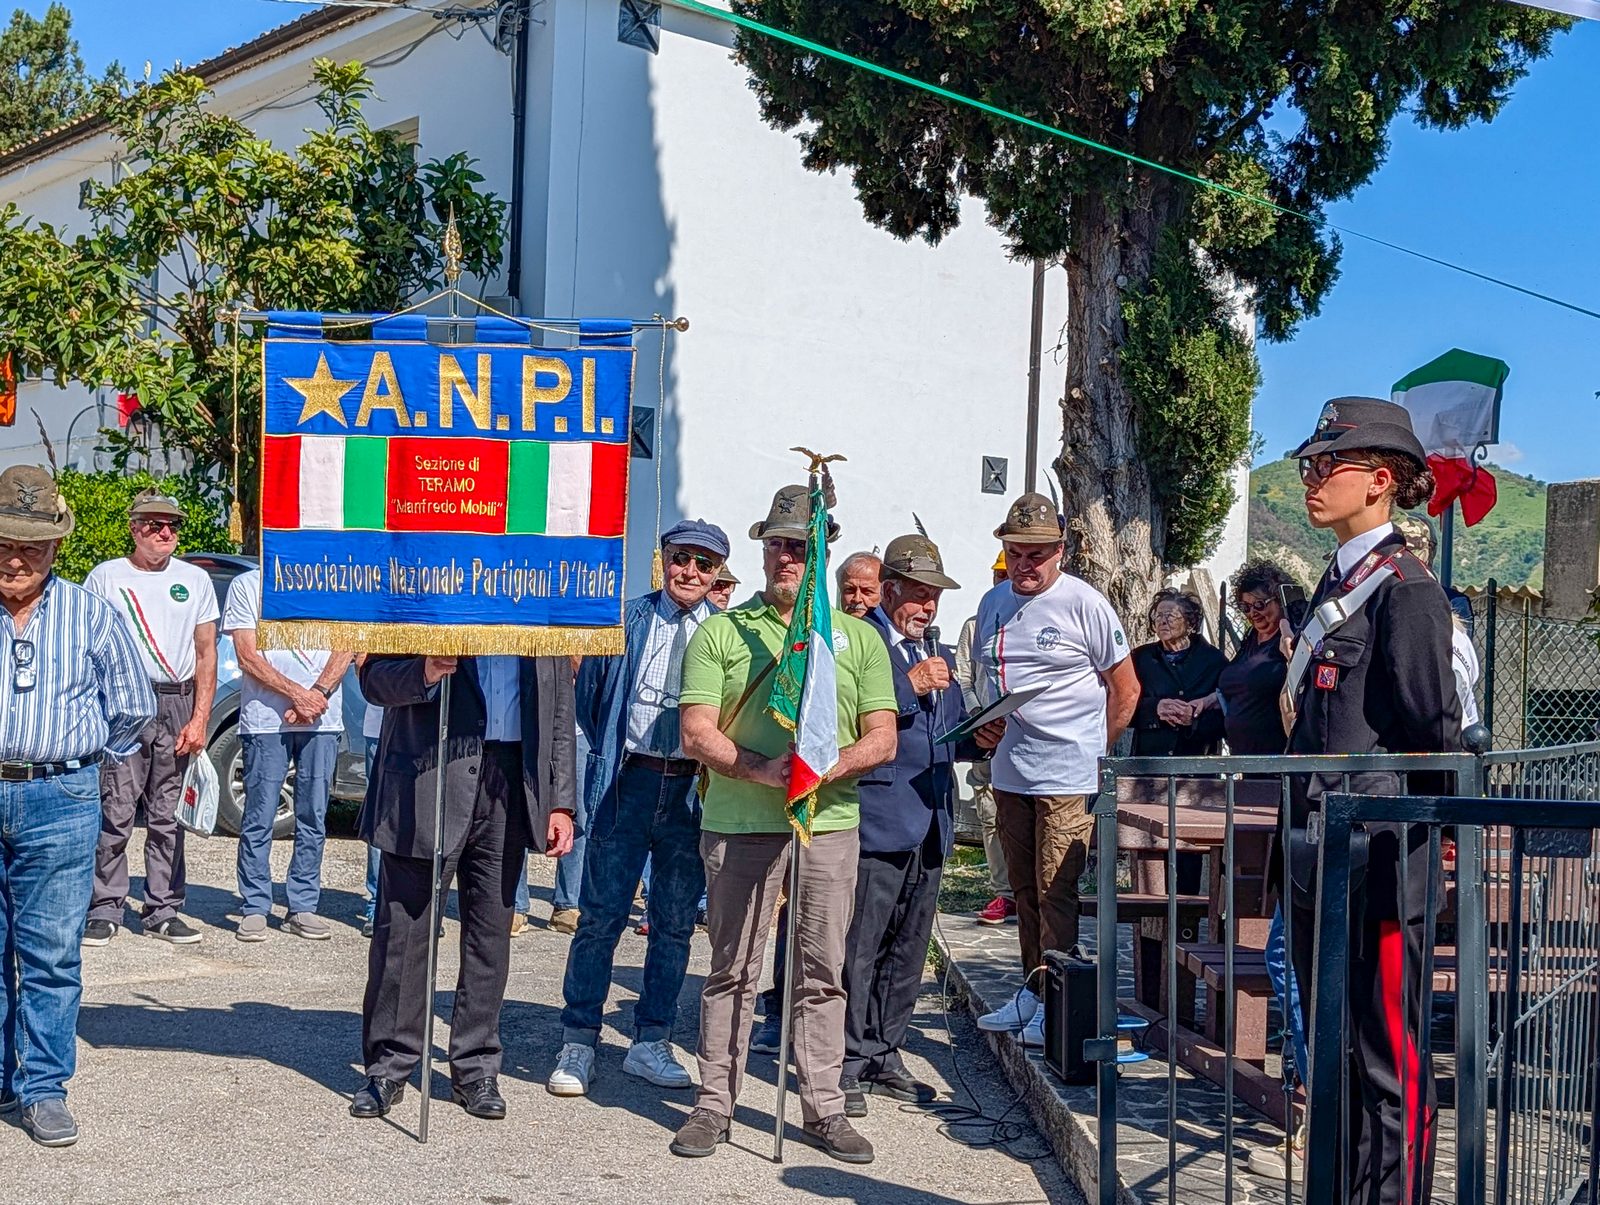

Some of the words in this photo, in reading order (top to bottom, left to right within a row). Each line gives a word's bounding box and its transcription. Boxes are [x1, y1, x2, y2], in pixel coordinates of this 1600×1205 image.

[354, 351, 614, 434] A.N.P.I.
[414, 454, 465, 471] Sezione
[468, 456, 480, 472] di
[418, 477, 475, 492] TERAMO
[274, 554, 381, 593] Associazione
[388, 556, 464, 595] Nazionale
[472, 557, 552, 603] Partigiani
[559, 560, 616, 598] D'Italia
